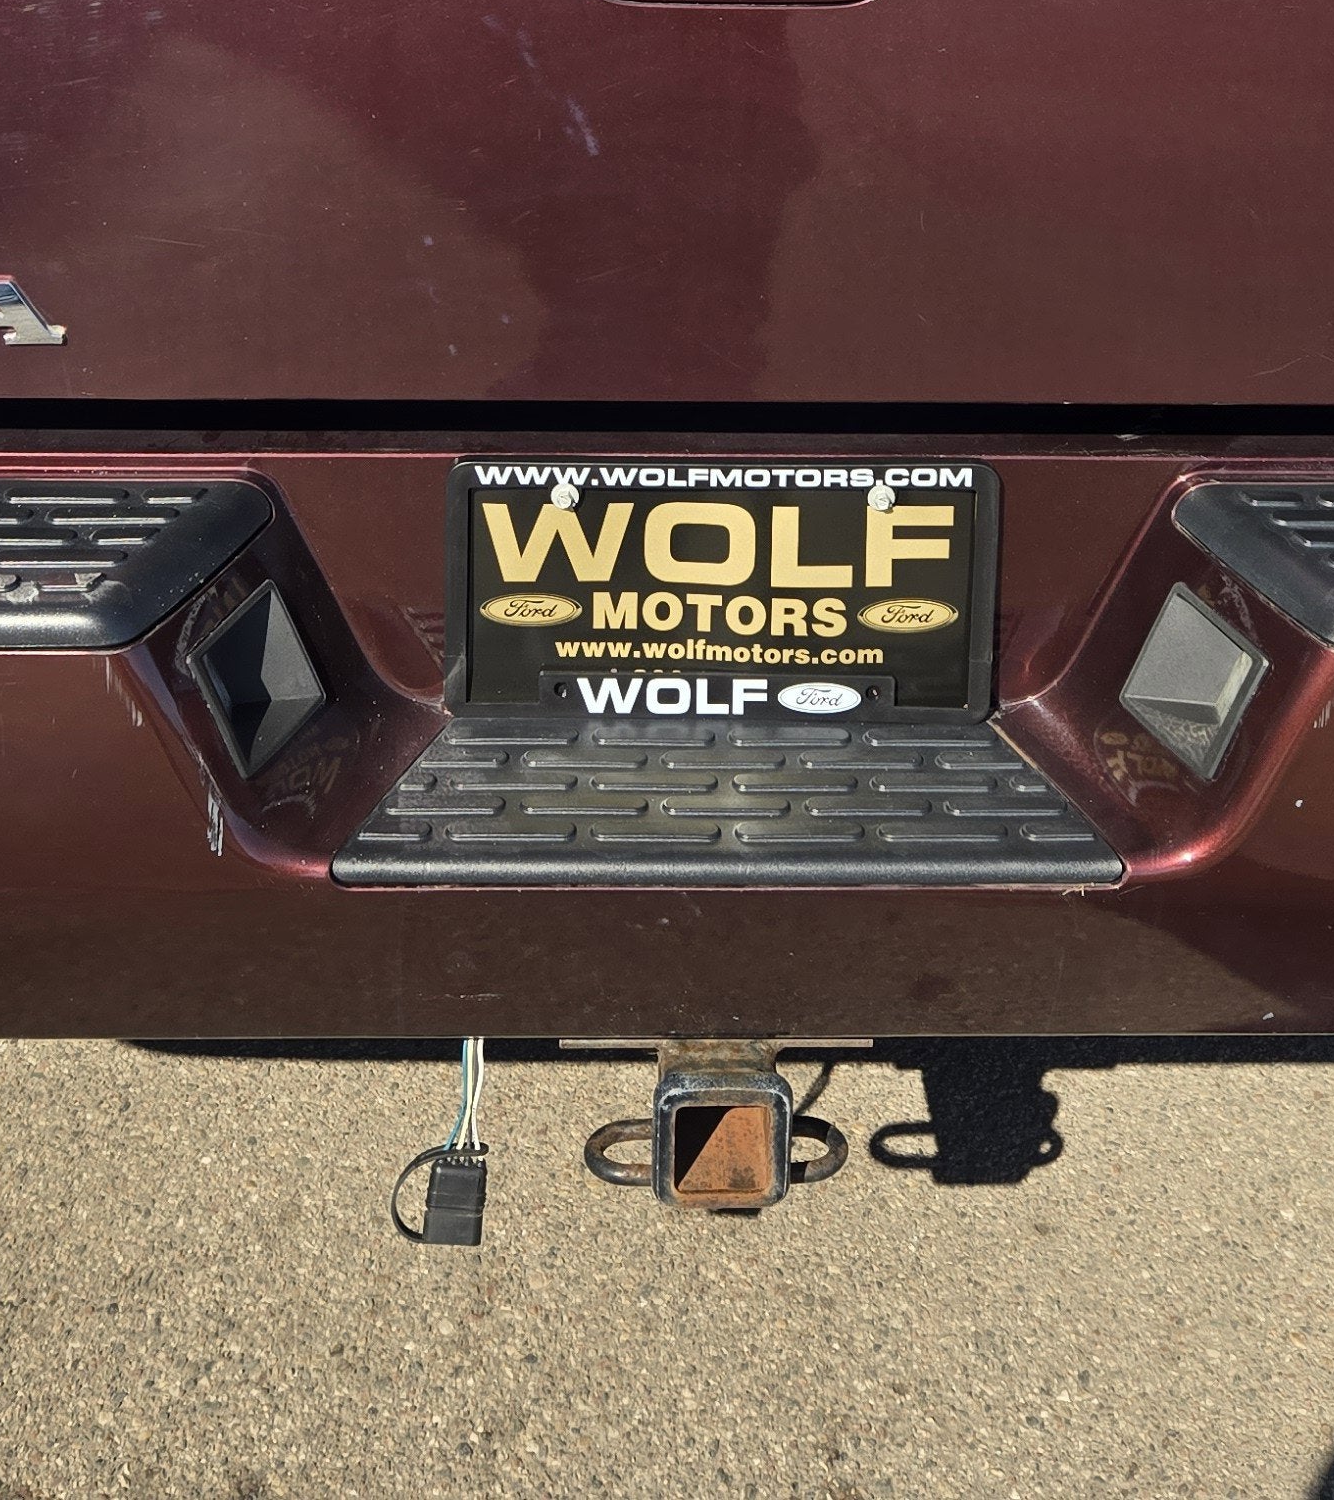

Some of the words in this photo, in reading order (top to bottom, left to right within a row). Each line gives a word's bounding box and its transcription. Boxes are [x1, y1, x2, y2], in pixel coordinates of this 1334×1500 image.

[474, 465, 973, 488] WWW.WOLFMOTORS.COM
[482, 501, 954, 588] WOLF
[592, 591, 848, 638] MOTORS
[555, 639, 884, 665] www.wolfmotors.com
[576, 677, 768, 715] WOLF
